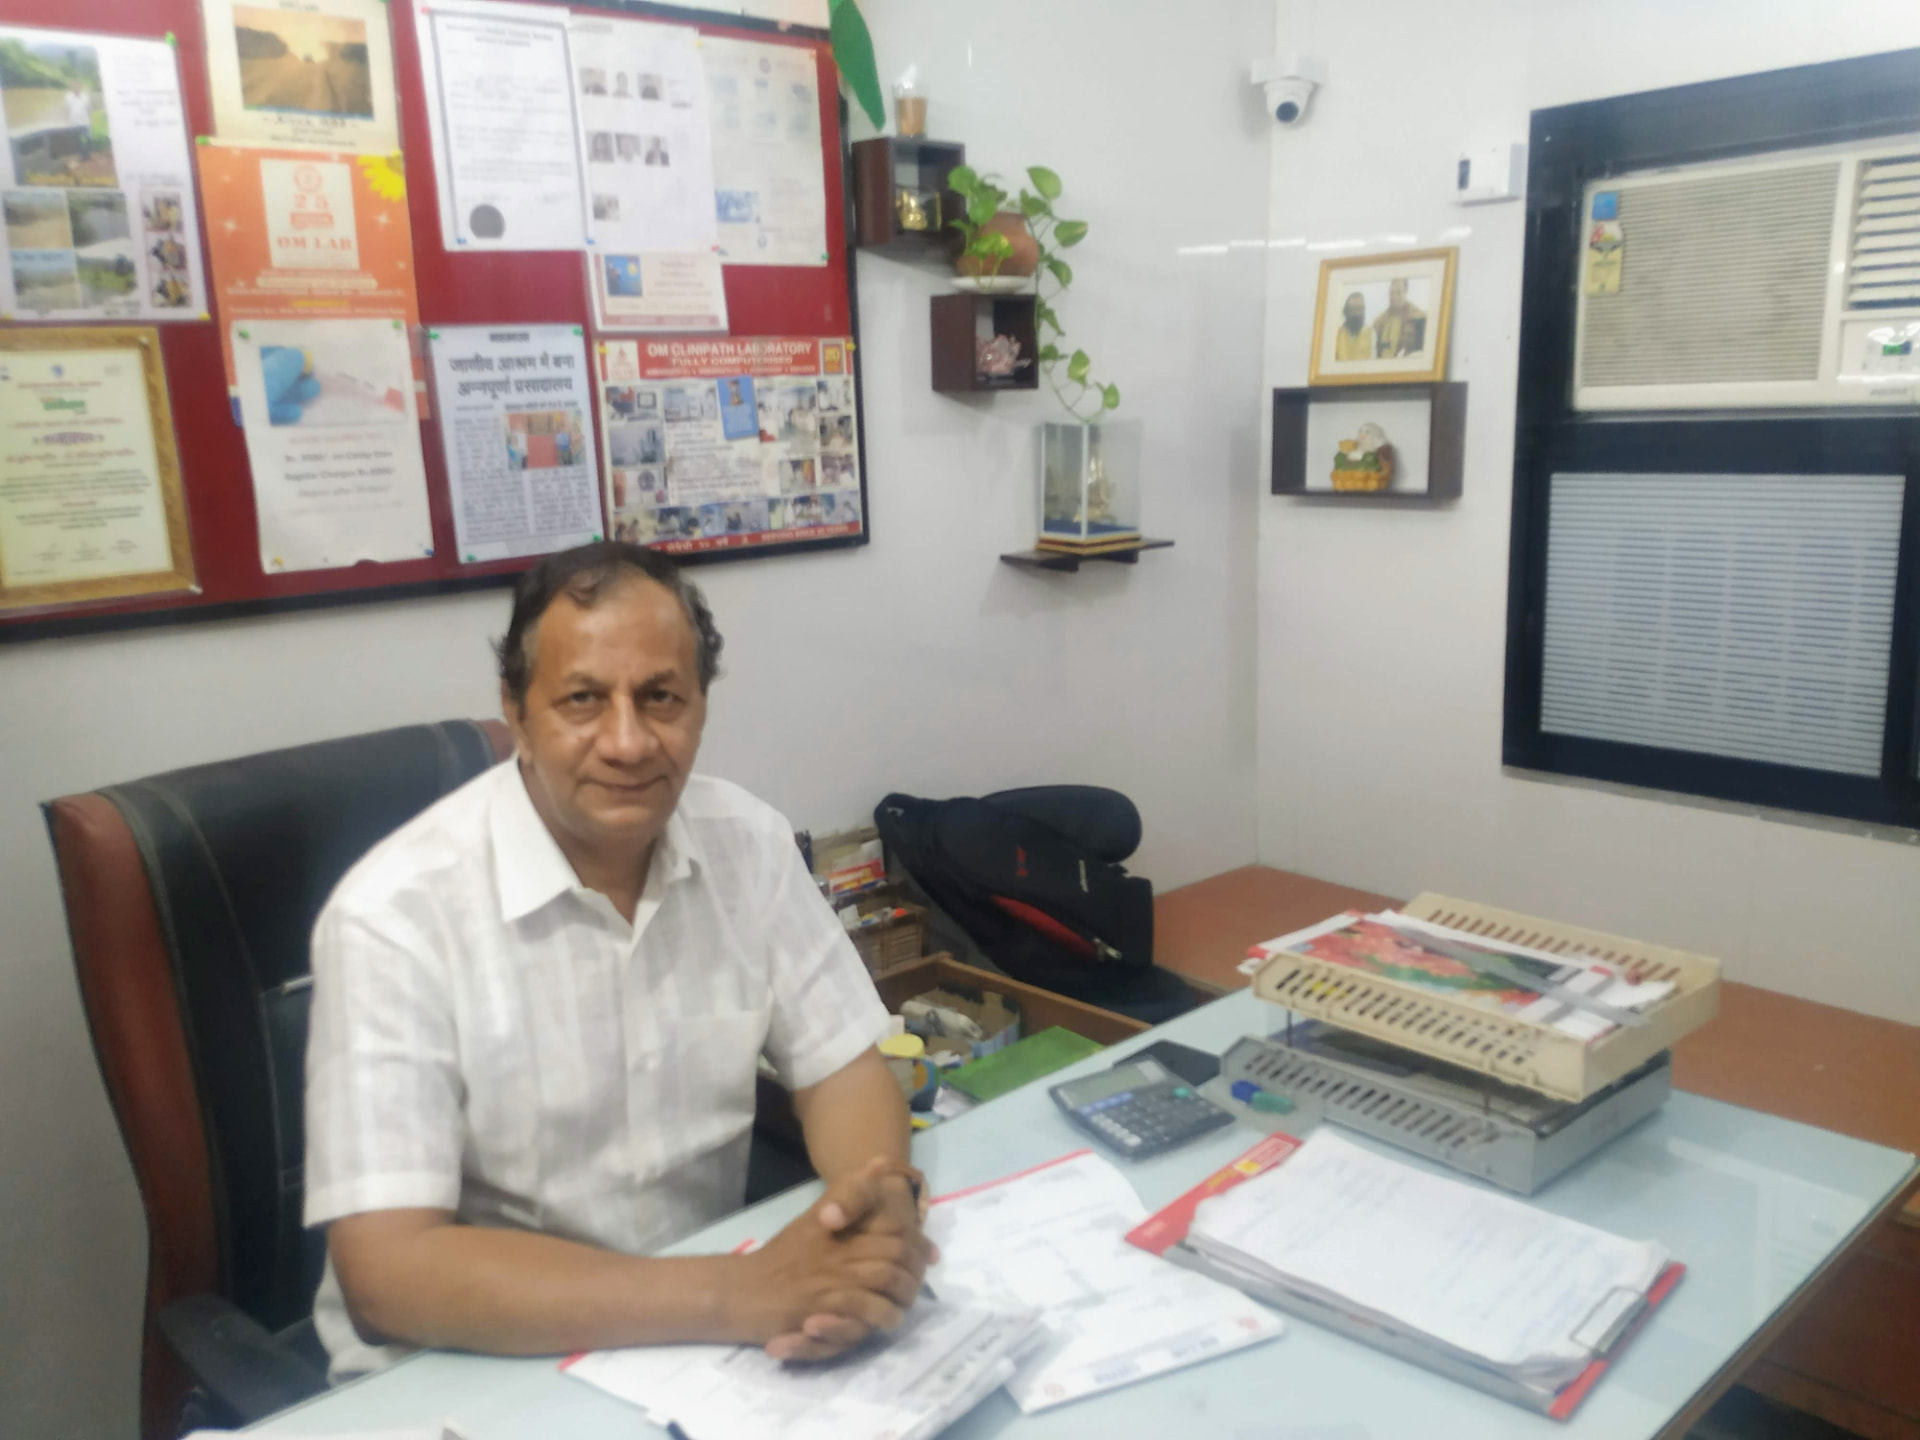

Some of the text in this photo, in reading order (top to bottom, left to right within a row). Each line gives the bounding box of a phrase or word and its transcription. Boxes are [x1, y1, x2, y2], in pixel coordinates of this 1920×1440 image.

[277, 235, 353, 250] OM LAB
[648, 342, 669, 357] OM
[671, 341, 735, 357] CLINIPATH
[498, 355, 537, 371] आश्रम
[552, 355, 576, 369] बना
[672, 357, 708, 367] FULLY
